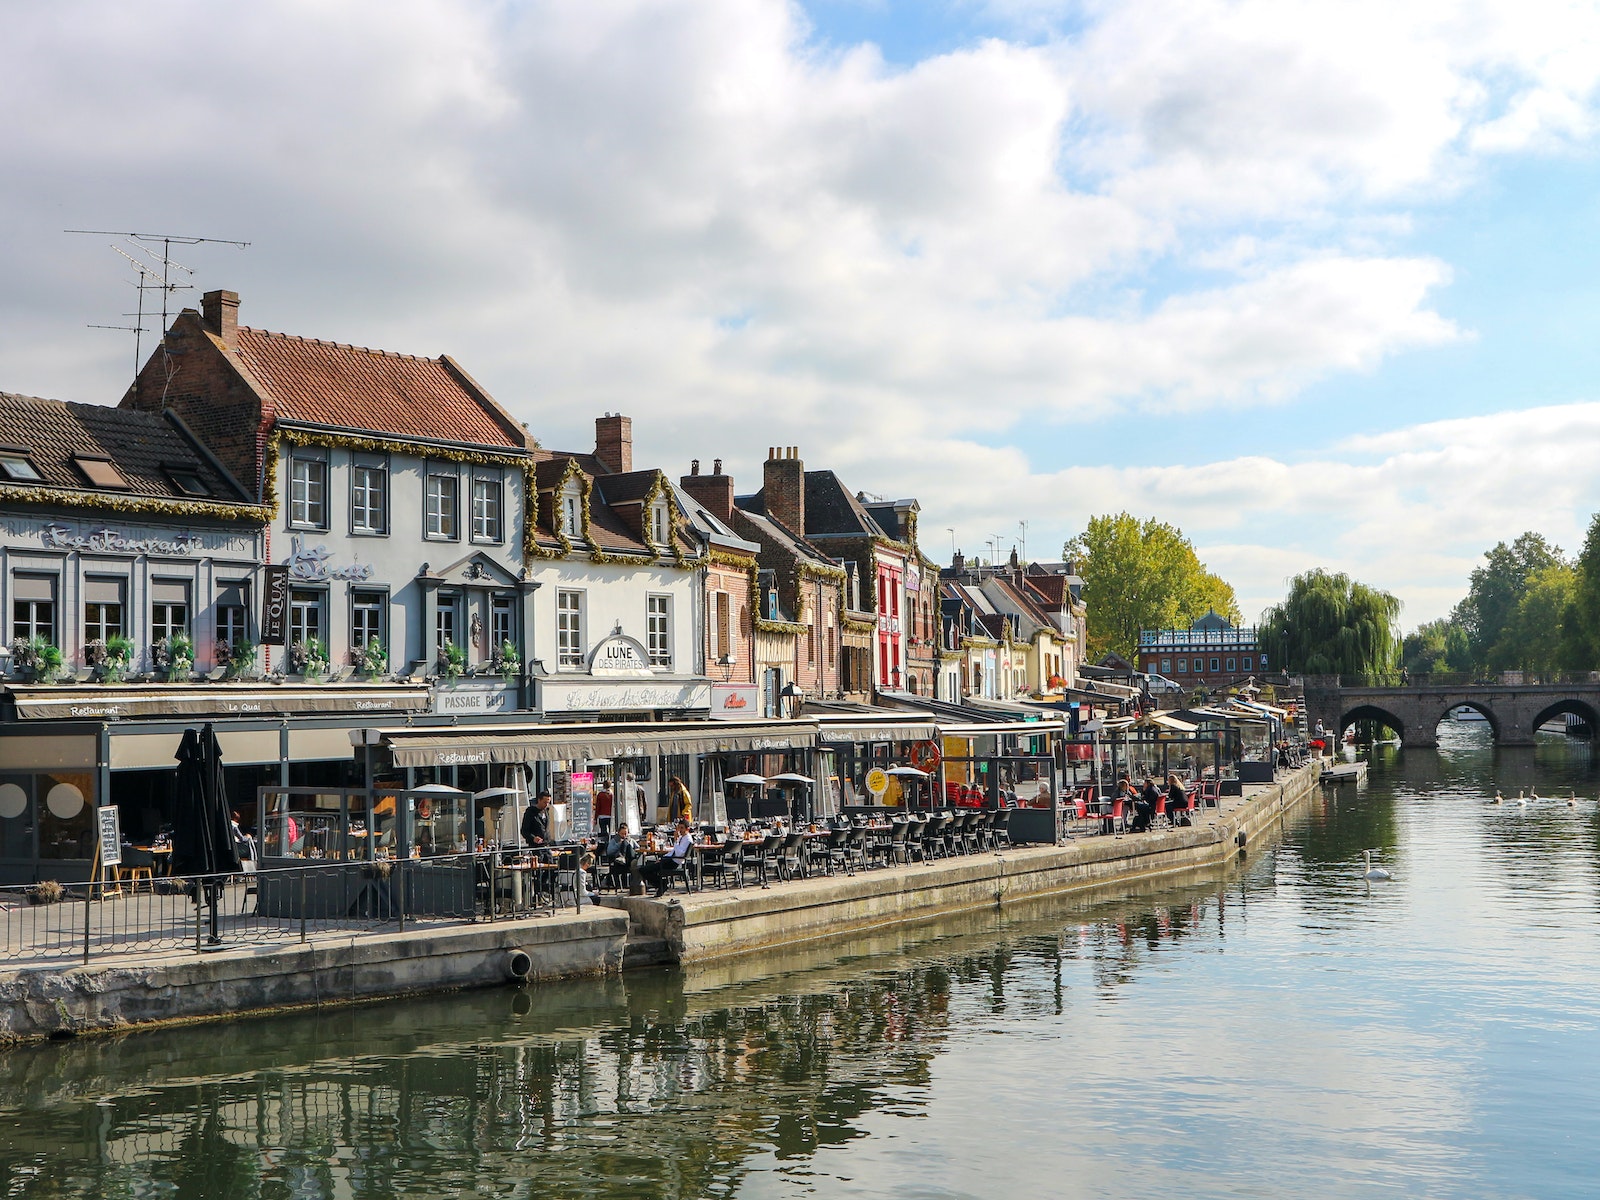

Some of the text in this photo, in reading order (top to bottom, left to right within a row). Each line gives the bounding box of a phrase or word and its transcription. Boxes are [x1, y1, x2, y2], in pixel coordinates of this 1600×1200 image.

[47, 522, 203, 554] Restaurant
[270, 571, 284, 637] LE QUAI
[607, 647, 632, 659] LUNE
[598, 658, 643, 669] DES PIRATES
[228, 702, 261, 711] Le Quai
[355, 700, 394, 710] Restaurant
[445, 695, 481, 708] PASSAGE
[70, 705, 121, 716] Restaurant
[437, 751, 487, 764] Restaurant
